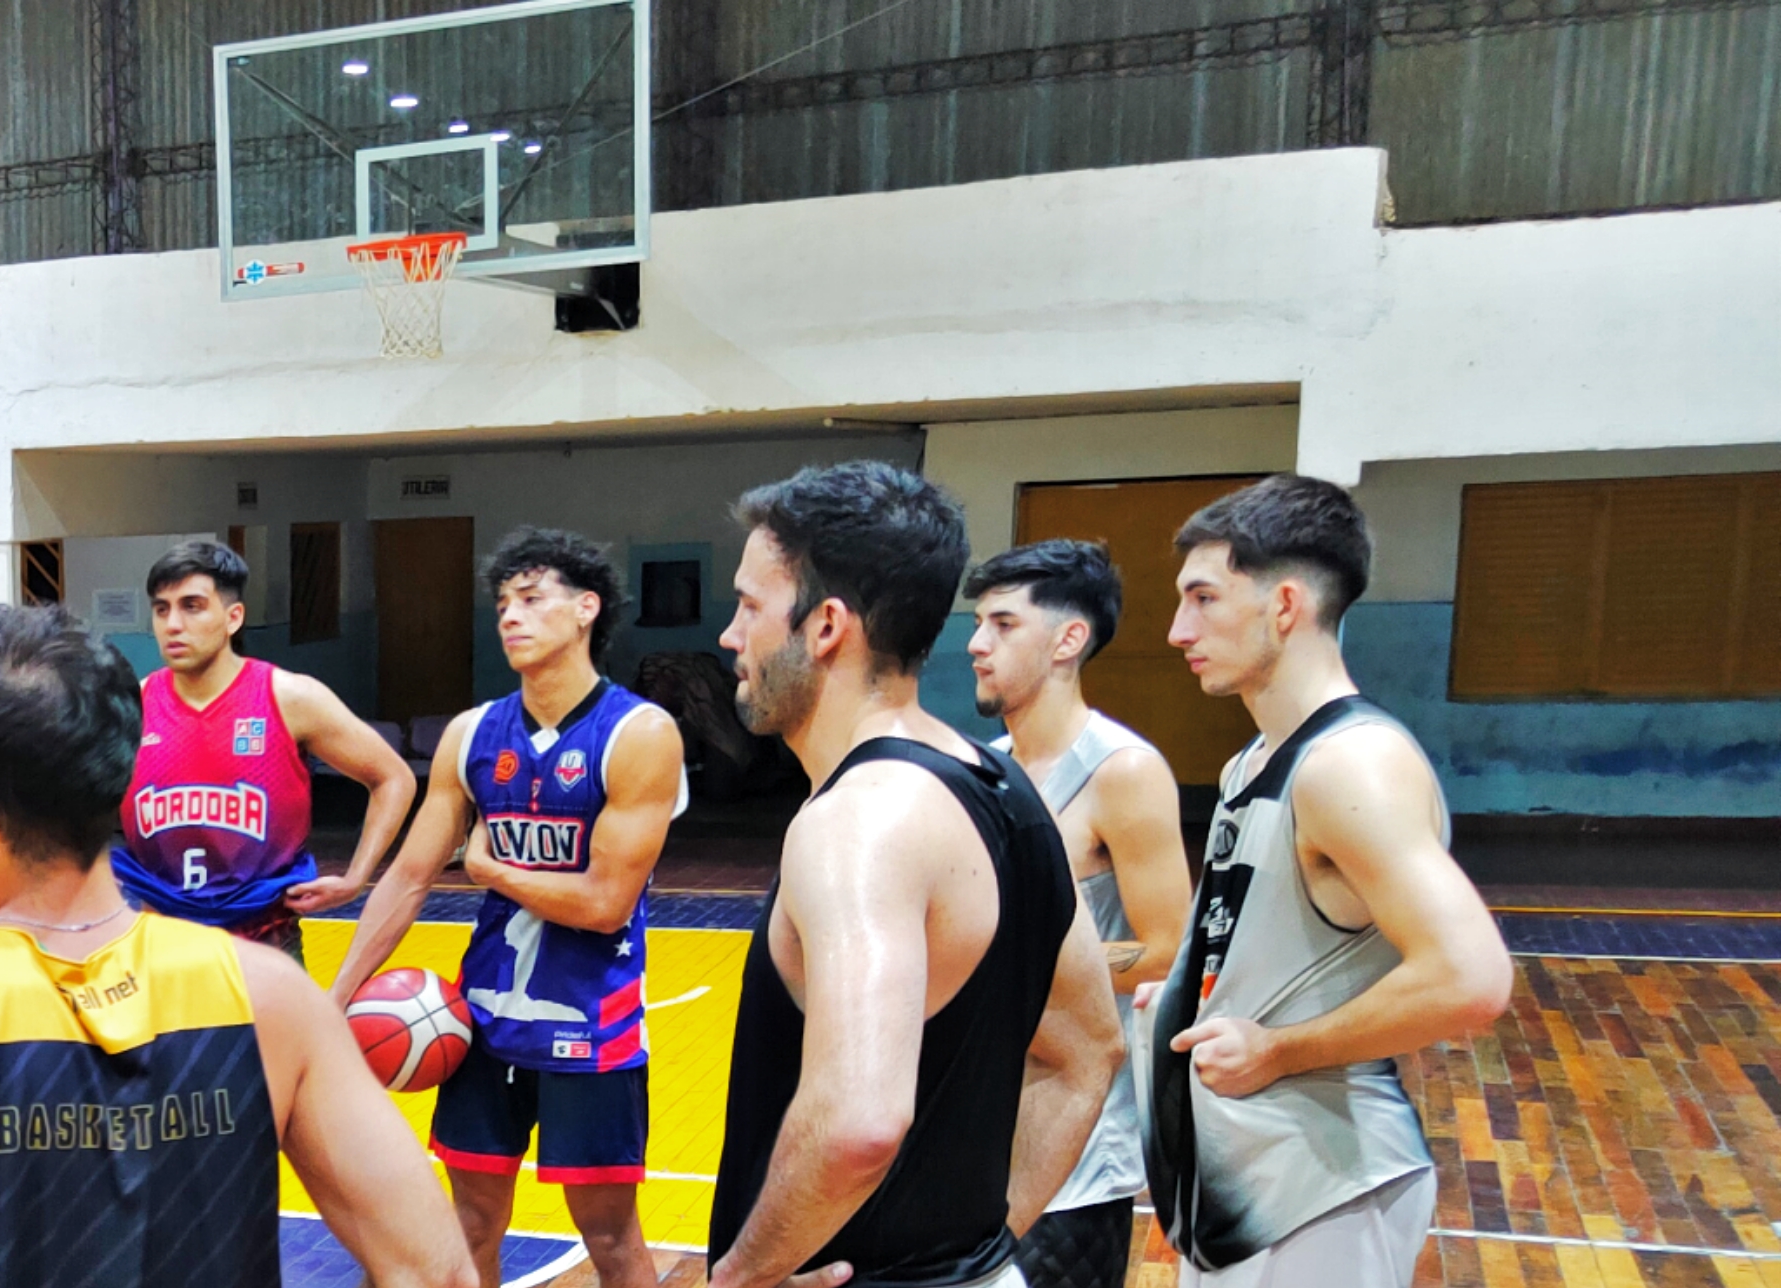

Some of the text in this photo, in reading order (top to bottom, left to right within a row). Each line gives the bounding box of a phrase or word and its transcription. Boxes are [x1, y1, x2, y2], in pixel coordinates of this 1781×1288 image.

[136, 787, 264, 837] CORDOBA
[183, 848, 207, 891] 6
[104, 971, 139, 1005] net
